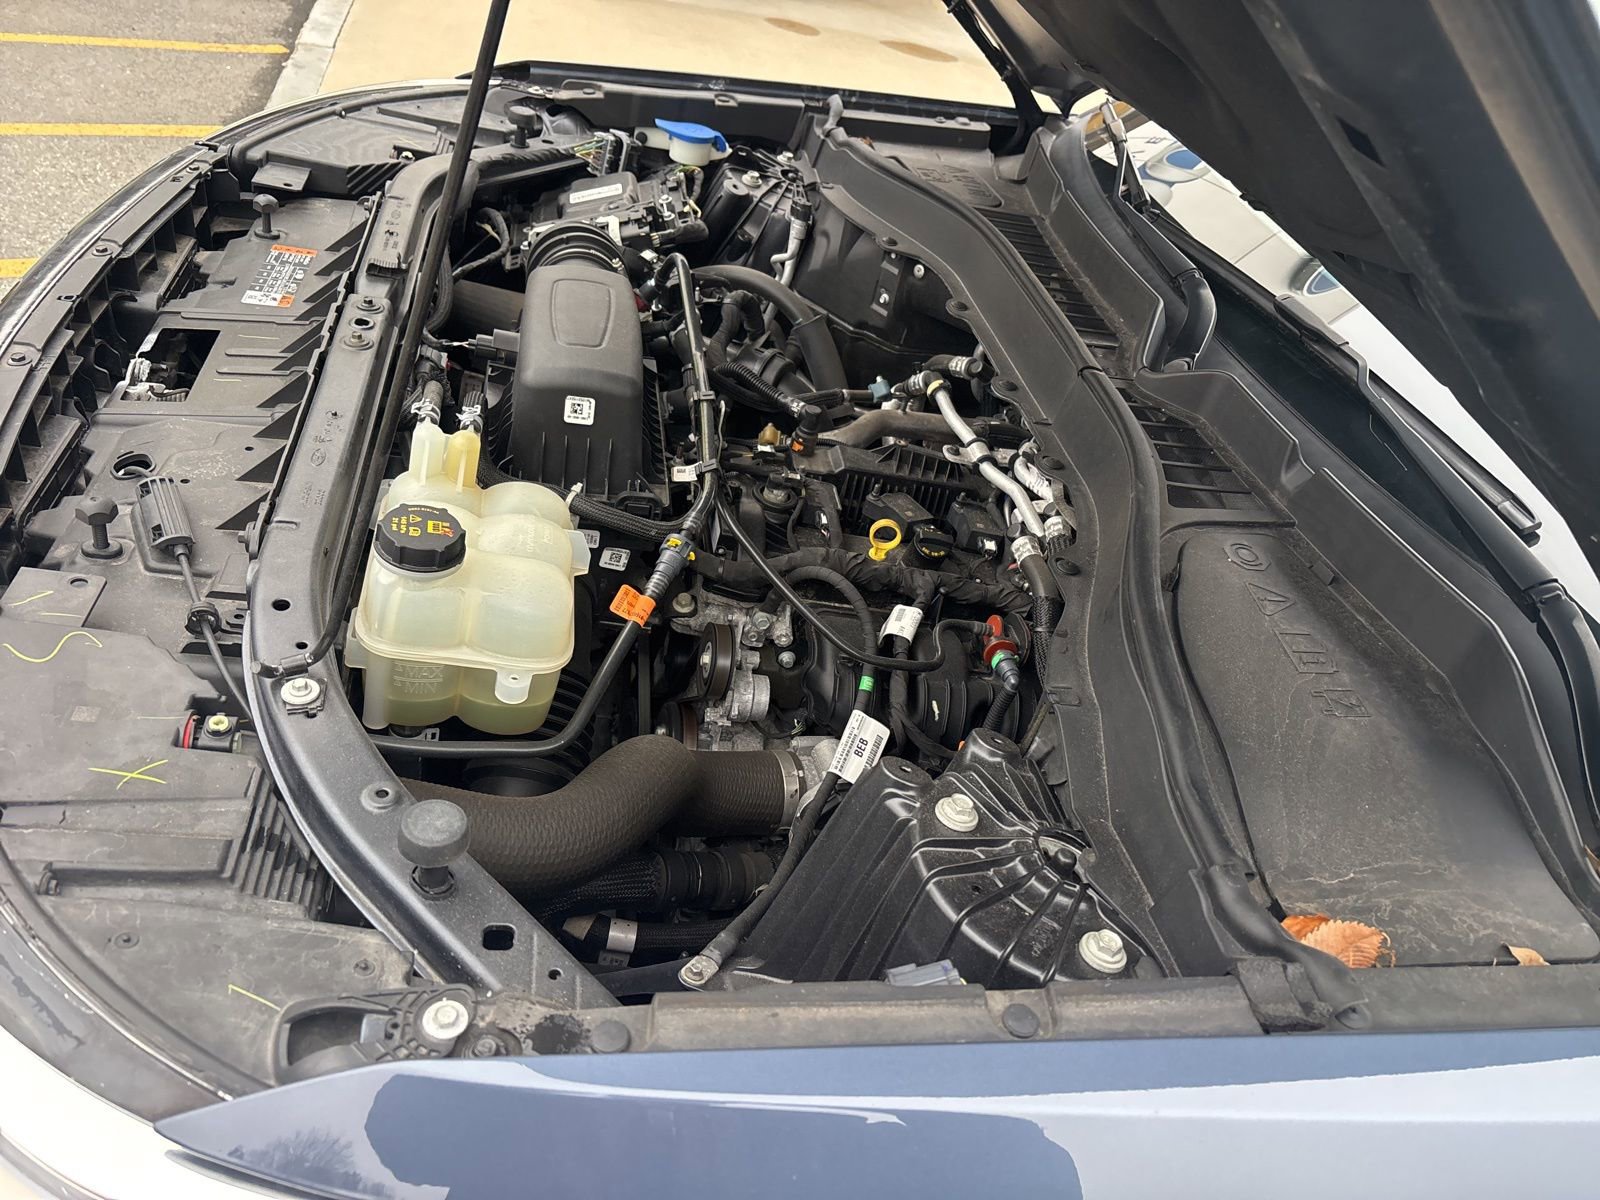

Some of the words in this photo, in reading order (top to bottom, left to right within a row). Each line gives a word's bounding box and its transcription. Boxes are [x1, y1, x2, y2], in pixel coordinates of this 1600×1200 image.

[404, 665, 443, 679] MAX
[404, 681, 438, 694] MIN
[853, 737, 869, 758] BEB
